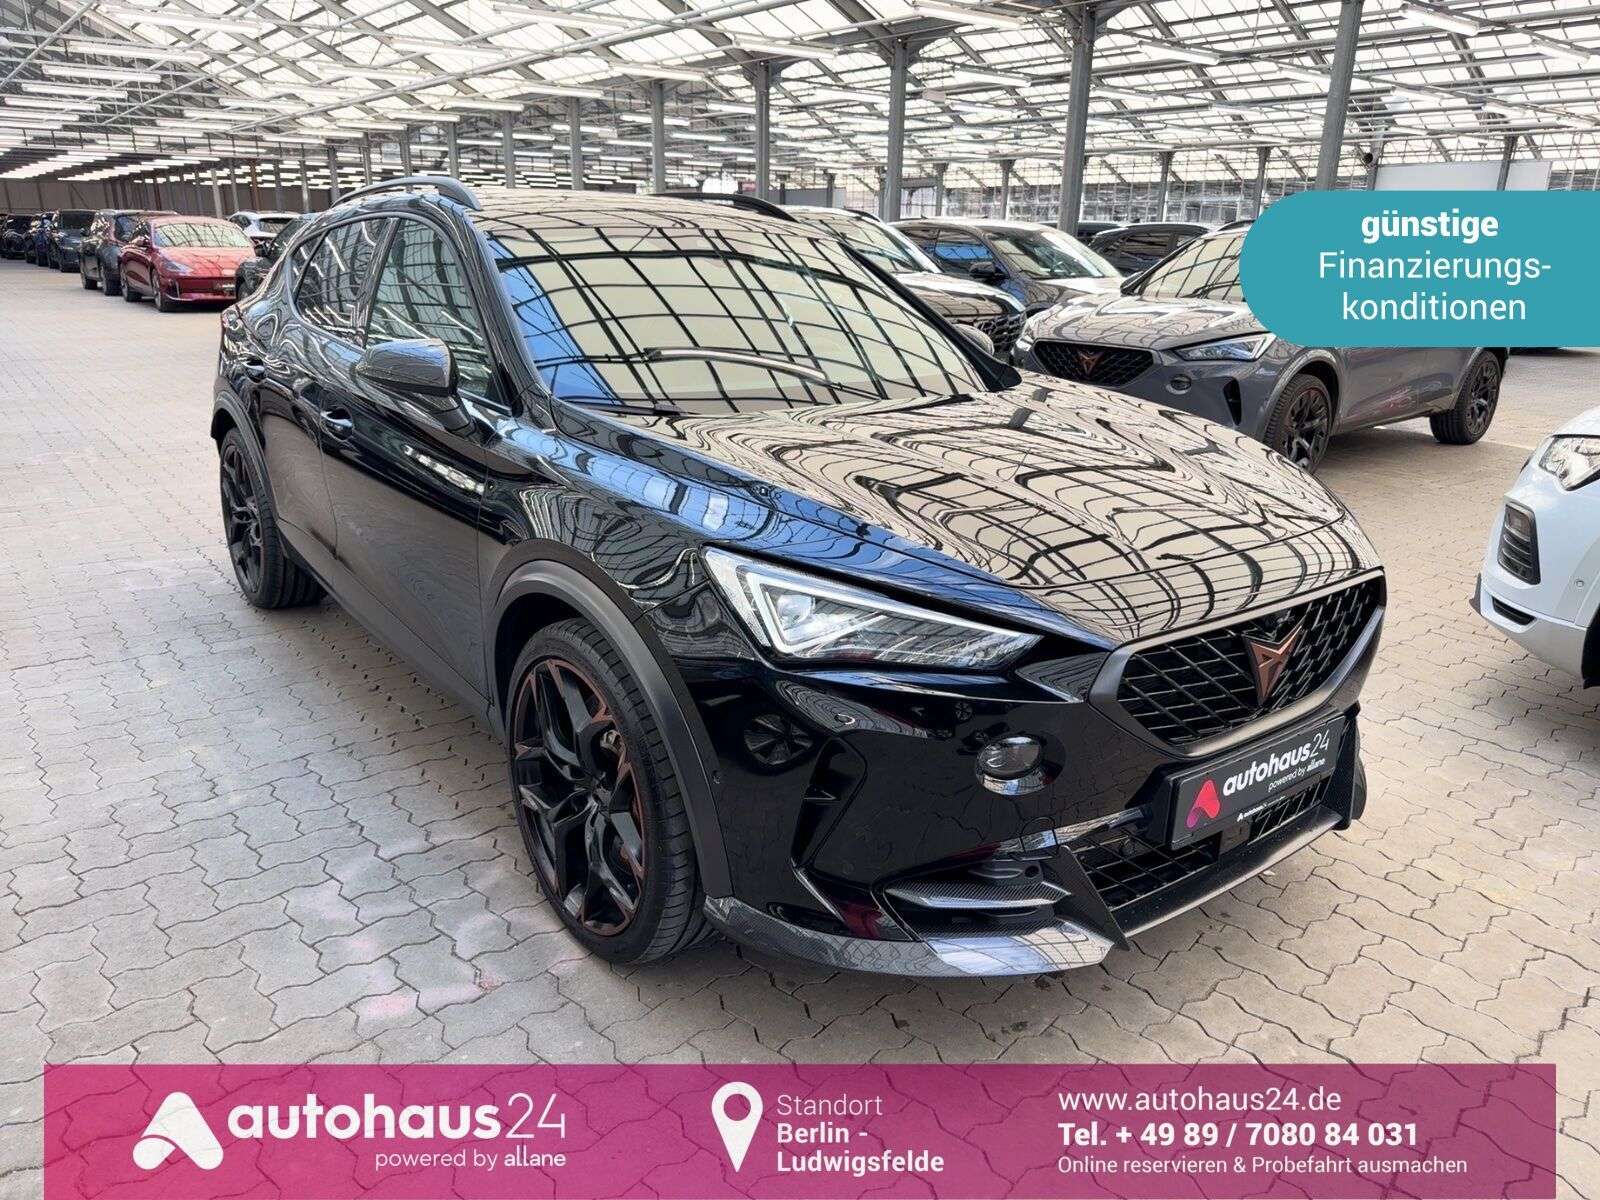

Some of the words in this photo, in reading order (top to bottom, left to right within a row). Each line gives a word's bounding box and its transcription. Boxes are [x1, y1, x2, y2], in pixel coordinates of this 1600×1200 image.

[1223, 729, 1330, 796] autohaus24
[1268, 771, 1298, 792] powered
[1298, 766, 1307, 777] by
